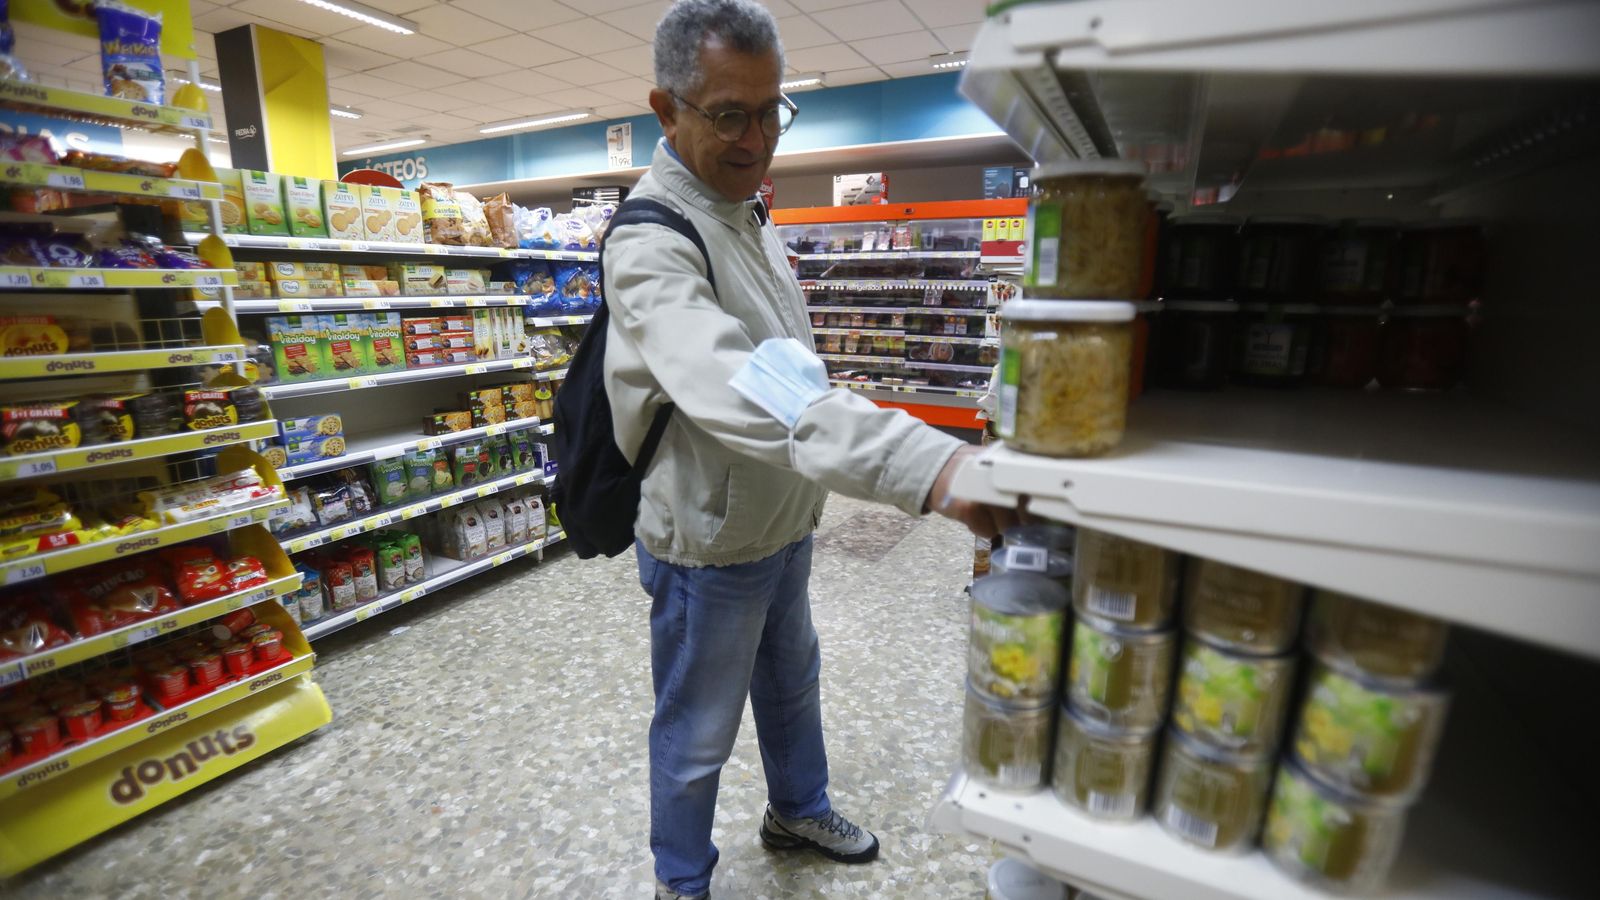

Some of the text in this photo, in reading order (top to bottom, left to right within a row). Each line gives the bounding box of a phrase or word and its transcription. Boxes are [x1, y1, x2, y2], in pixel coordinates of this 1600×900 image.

[0, 81, 48, 100] onuts
[46, 358, 95, 372] donuts
[193, 413, 232, 430] donuts
[13, 432, 71, 455] donuts
[203, 431, 241, 445] donuts
[87, 447, 134, 463] donuts
[115, 536, 160, 553] donuts
[249, 672, 283, 691] donuts
[147, 711, 188, 733] donuts
[18, 760, 70, 788] donuts
[110, 725, 256, 809] donuts
